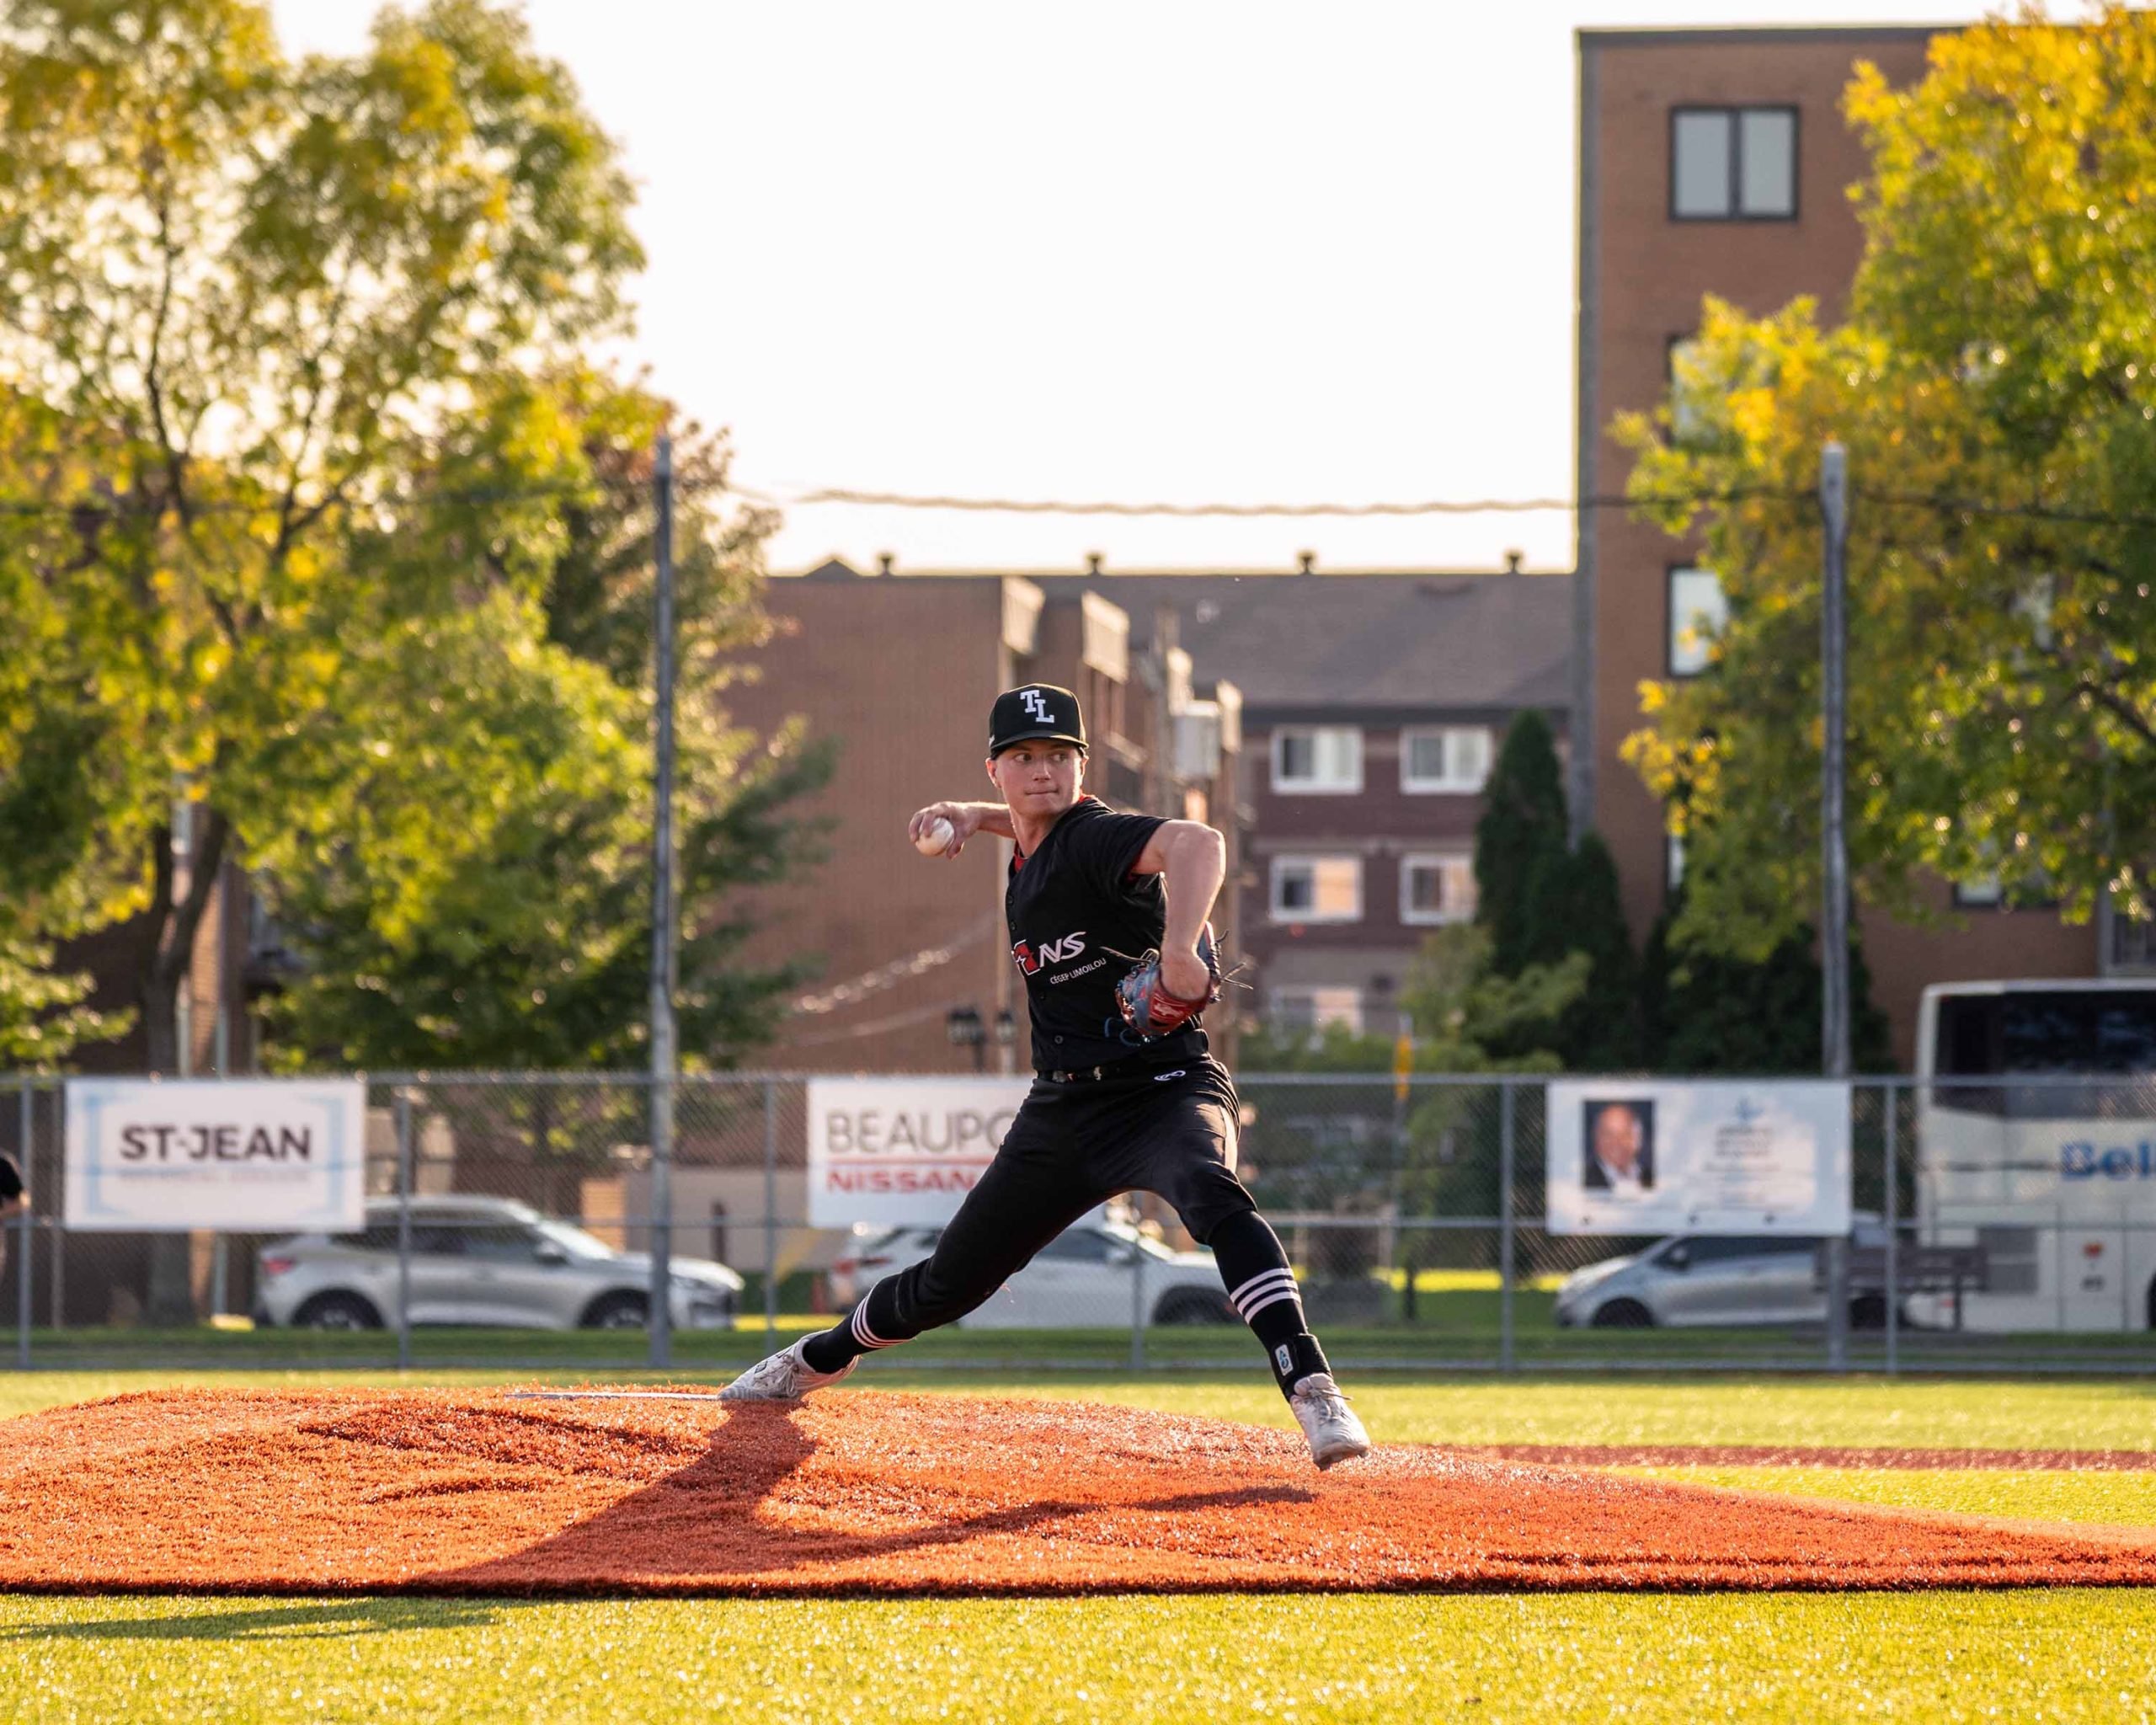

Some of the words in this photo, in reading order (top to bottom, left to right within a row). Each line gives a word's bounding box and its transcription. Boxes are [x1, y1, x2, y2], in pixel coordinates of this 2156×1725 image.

[1069, 957, 1107, 980] LIMOILOU
[120, 1124, 312, 1162] ST-JEAN
[825, 1170, 975, 1192] NISSAN
